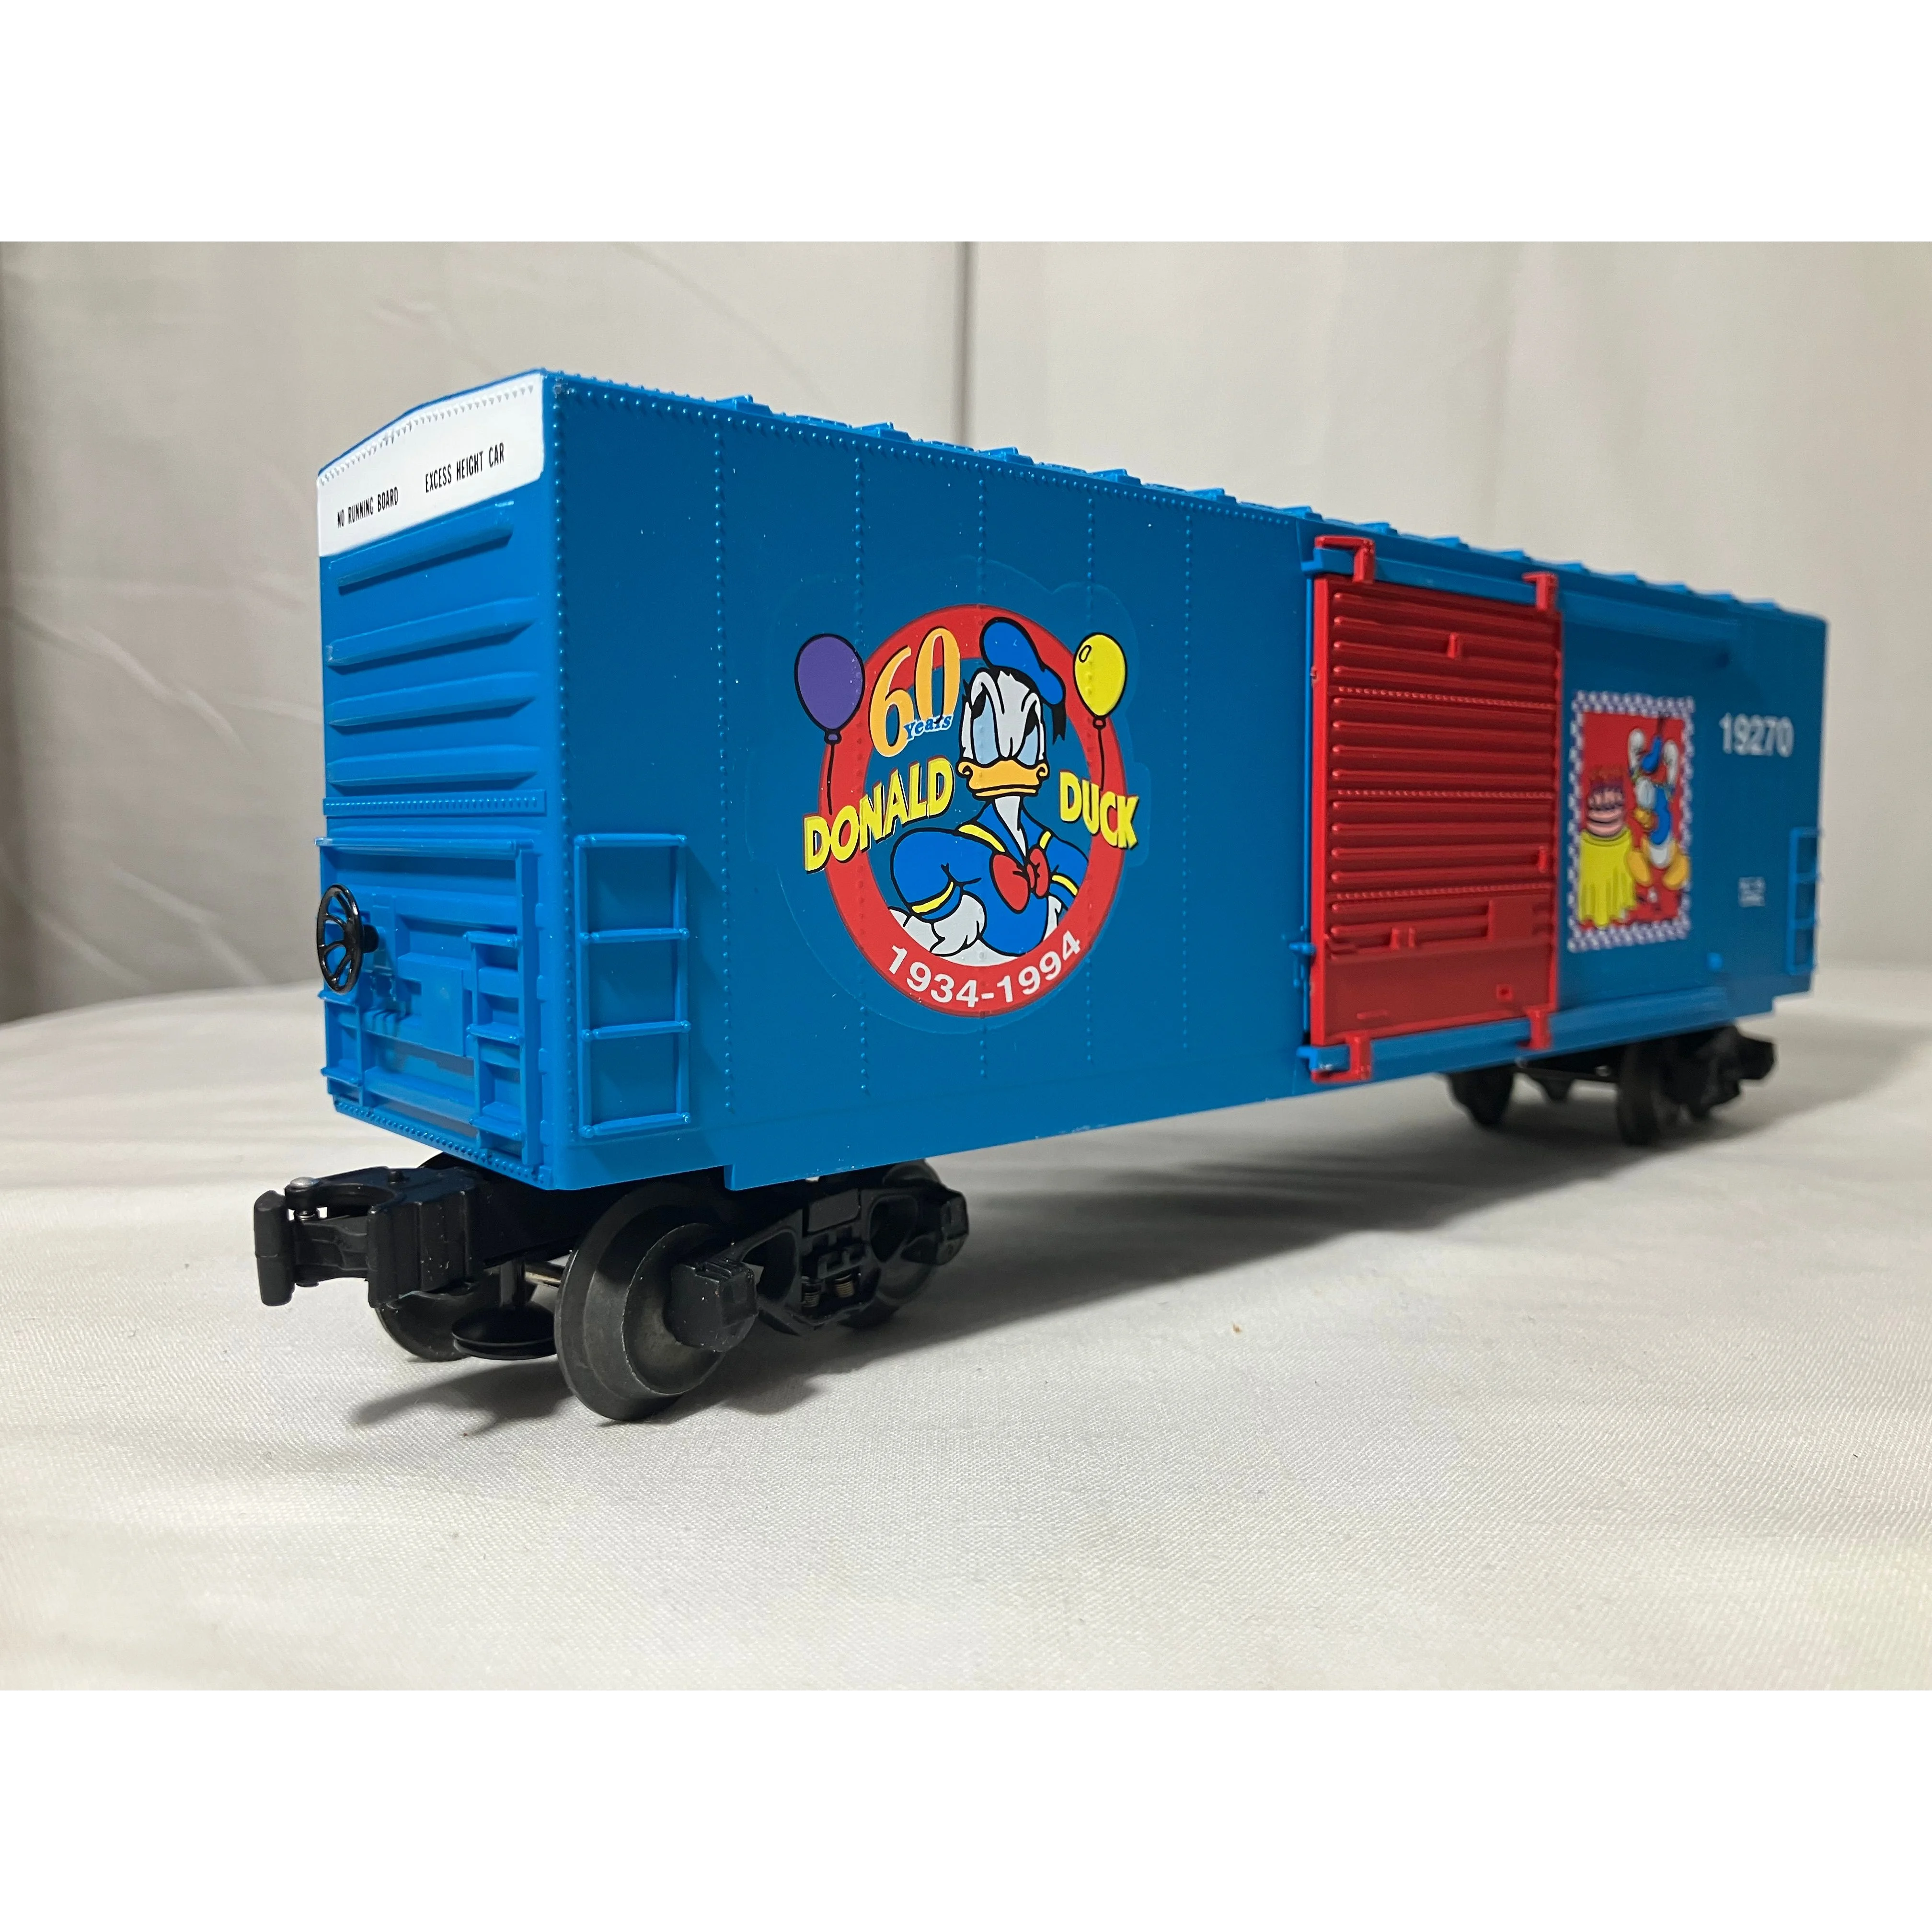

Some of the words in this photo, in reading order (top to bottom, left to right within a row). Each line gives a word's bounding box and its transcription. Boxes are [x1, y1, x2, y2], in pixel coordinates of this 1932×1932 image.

[425, 464, 452, 493] EXCESS
[456, 450, 484, 482] HEIGHT
[488, 441, 505, 468] CAR
[337, 509, 345, 529] NO
[348, 496, 374, 524] RUNNING
[377, 486, 399, 512] BOARD
[868, 626, 961, 757] 60
[903, 715, 953, 740] Years
[1719, 712, 1794, 758] 19270
[804, 756, 955, 874] DONALD
[1059, 770, 1140, 850] DUCK
[888, 930, 1081, 1008] 1934-1994
